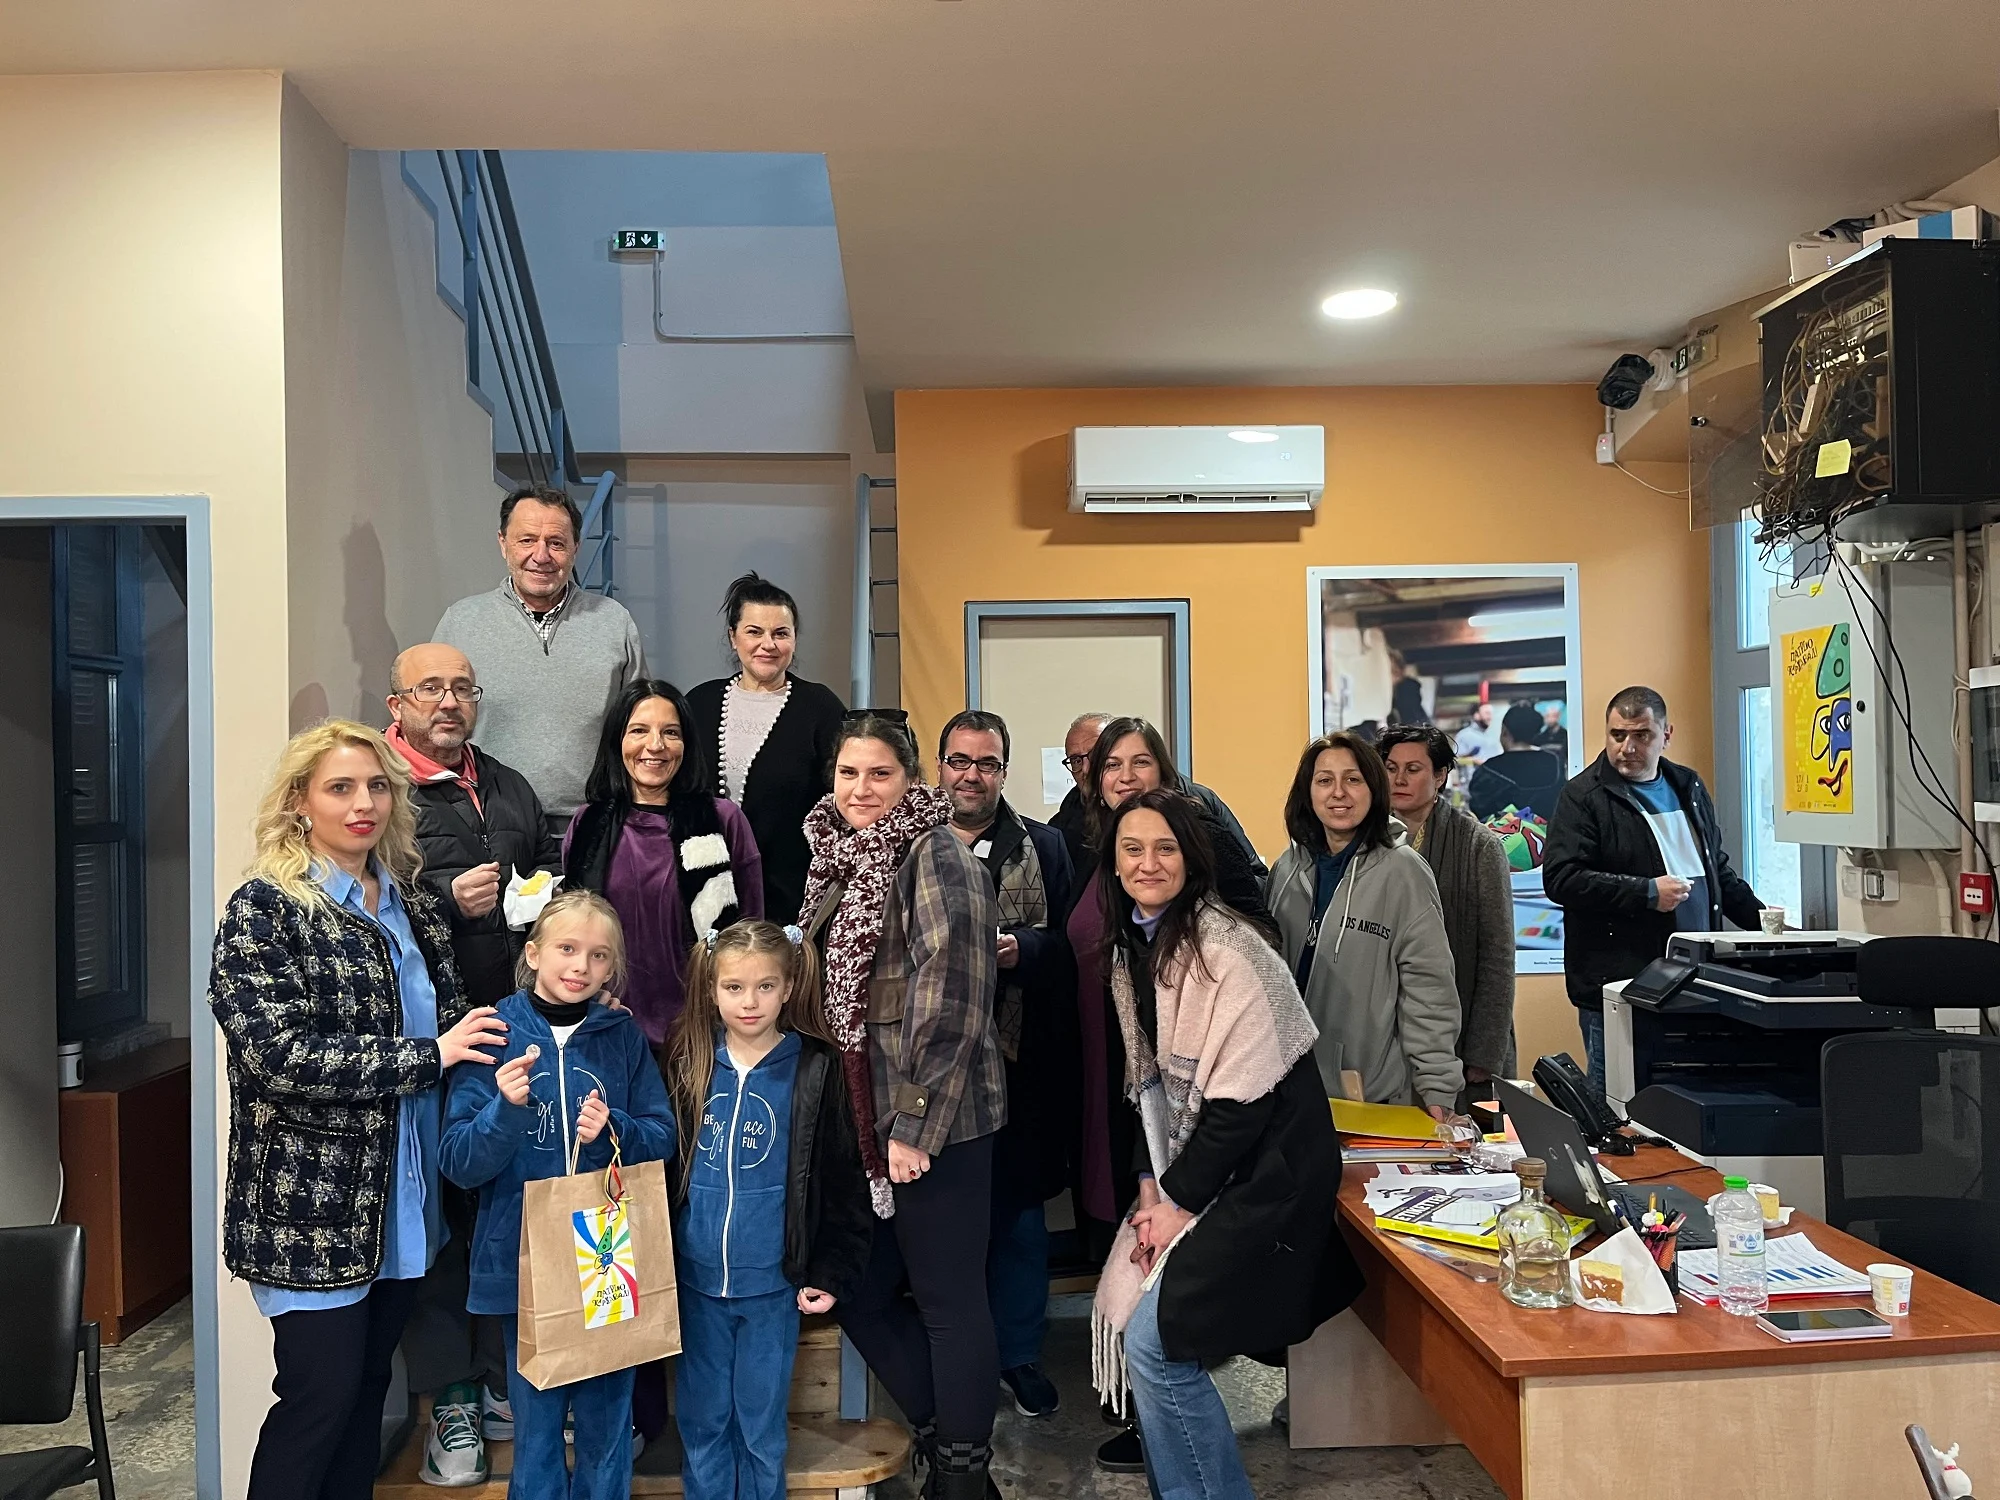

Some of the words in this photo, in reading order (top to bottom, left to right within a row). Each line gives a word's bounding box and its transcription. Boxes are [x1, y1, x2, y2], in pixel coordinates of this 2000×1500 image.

[1357, 919, 1391, 940] ANGELES
[703, 1113, 715, 1125] BE
[742, 1136, 758, 1150] FUL
